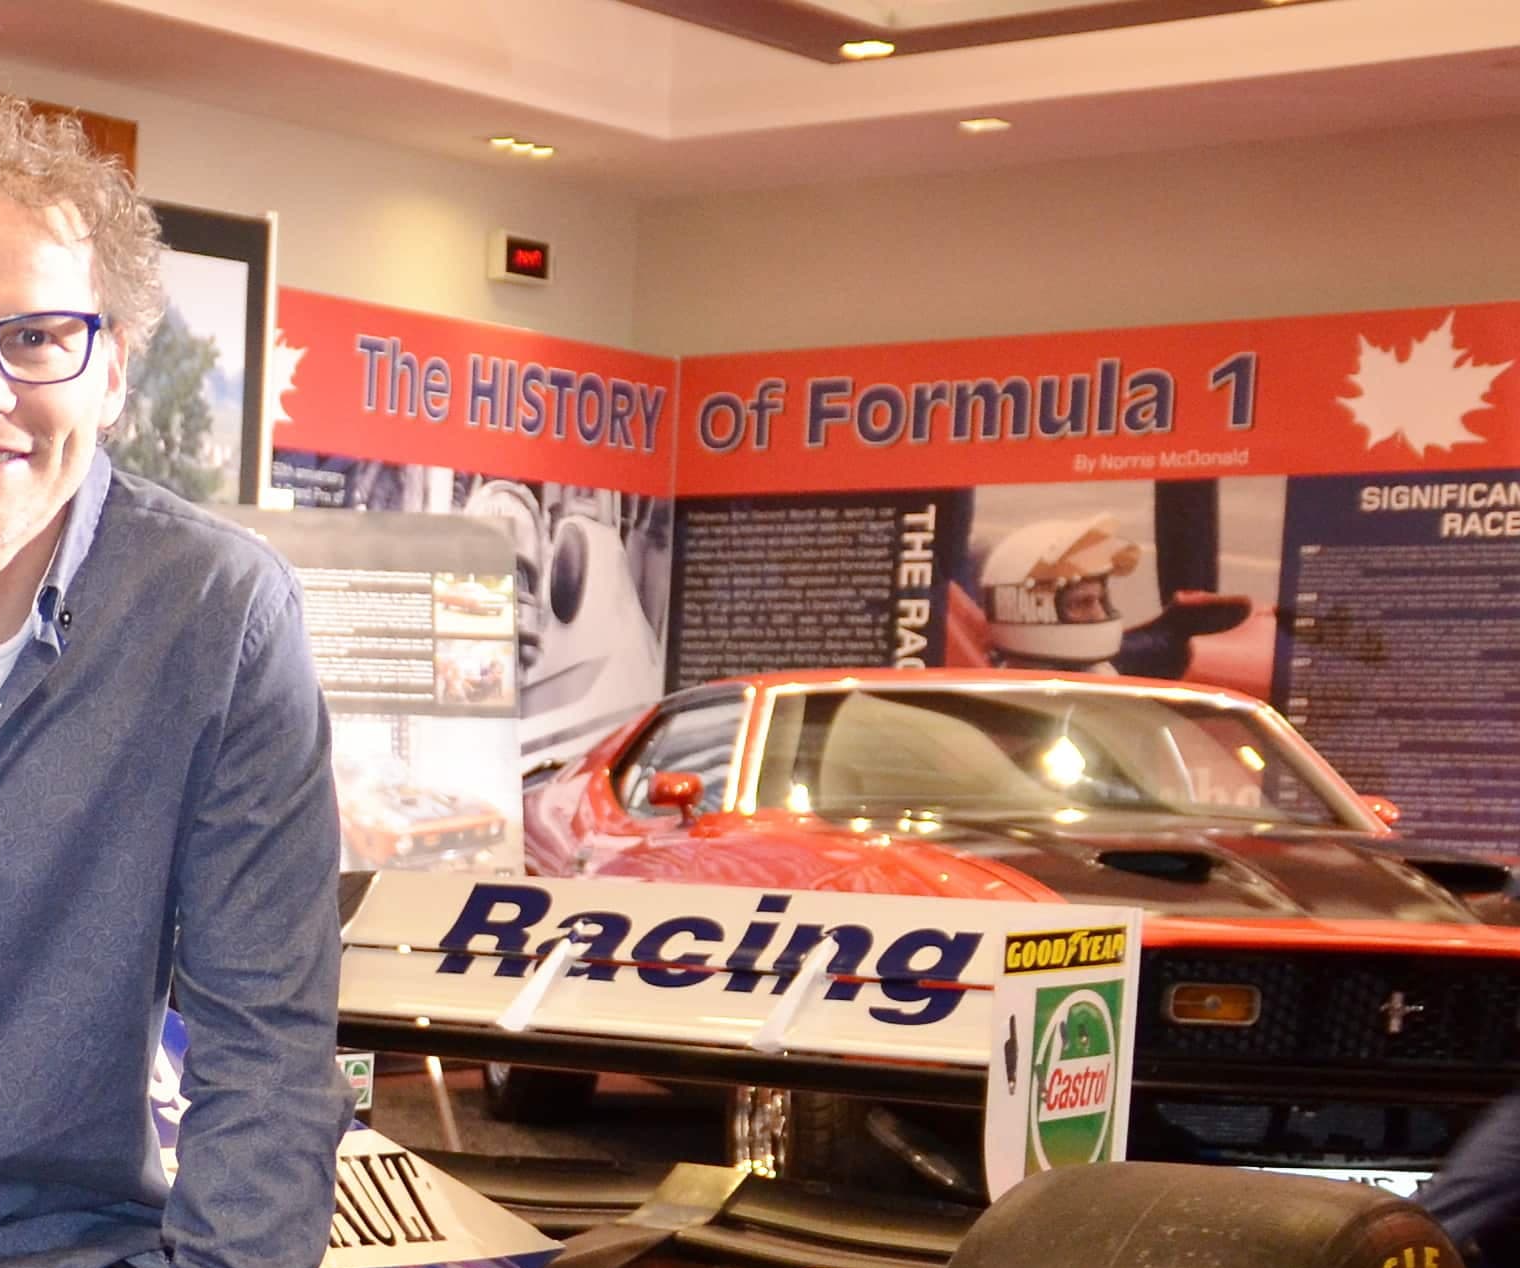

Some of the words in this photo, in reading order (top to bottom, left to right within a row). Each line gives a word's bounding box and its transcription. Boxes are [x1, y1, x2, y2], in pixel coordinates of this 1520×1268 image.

[356, 332, 452, 423] The
[467, 353, 667, 455] HISTORY
[805, 357, 1176, 450] Formula
[1209, 350, 1258, 432] 1
[1073, 453, 1097, 473] By
[1100, 452, 1156, 470] Norris
[1159, 448, 1250, 469] McDonald
[899, 503, 937, 588] THE
[436, 882, 984, 1026] Racing
[1045, 1062, 1111, 1111] Castrol
